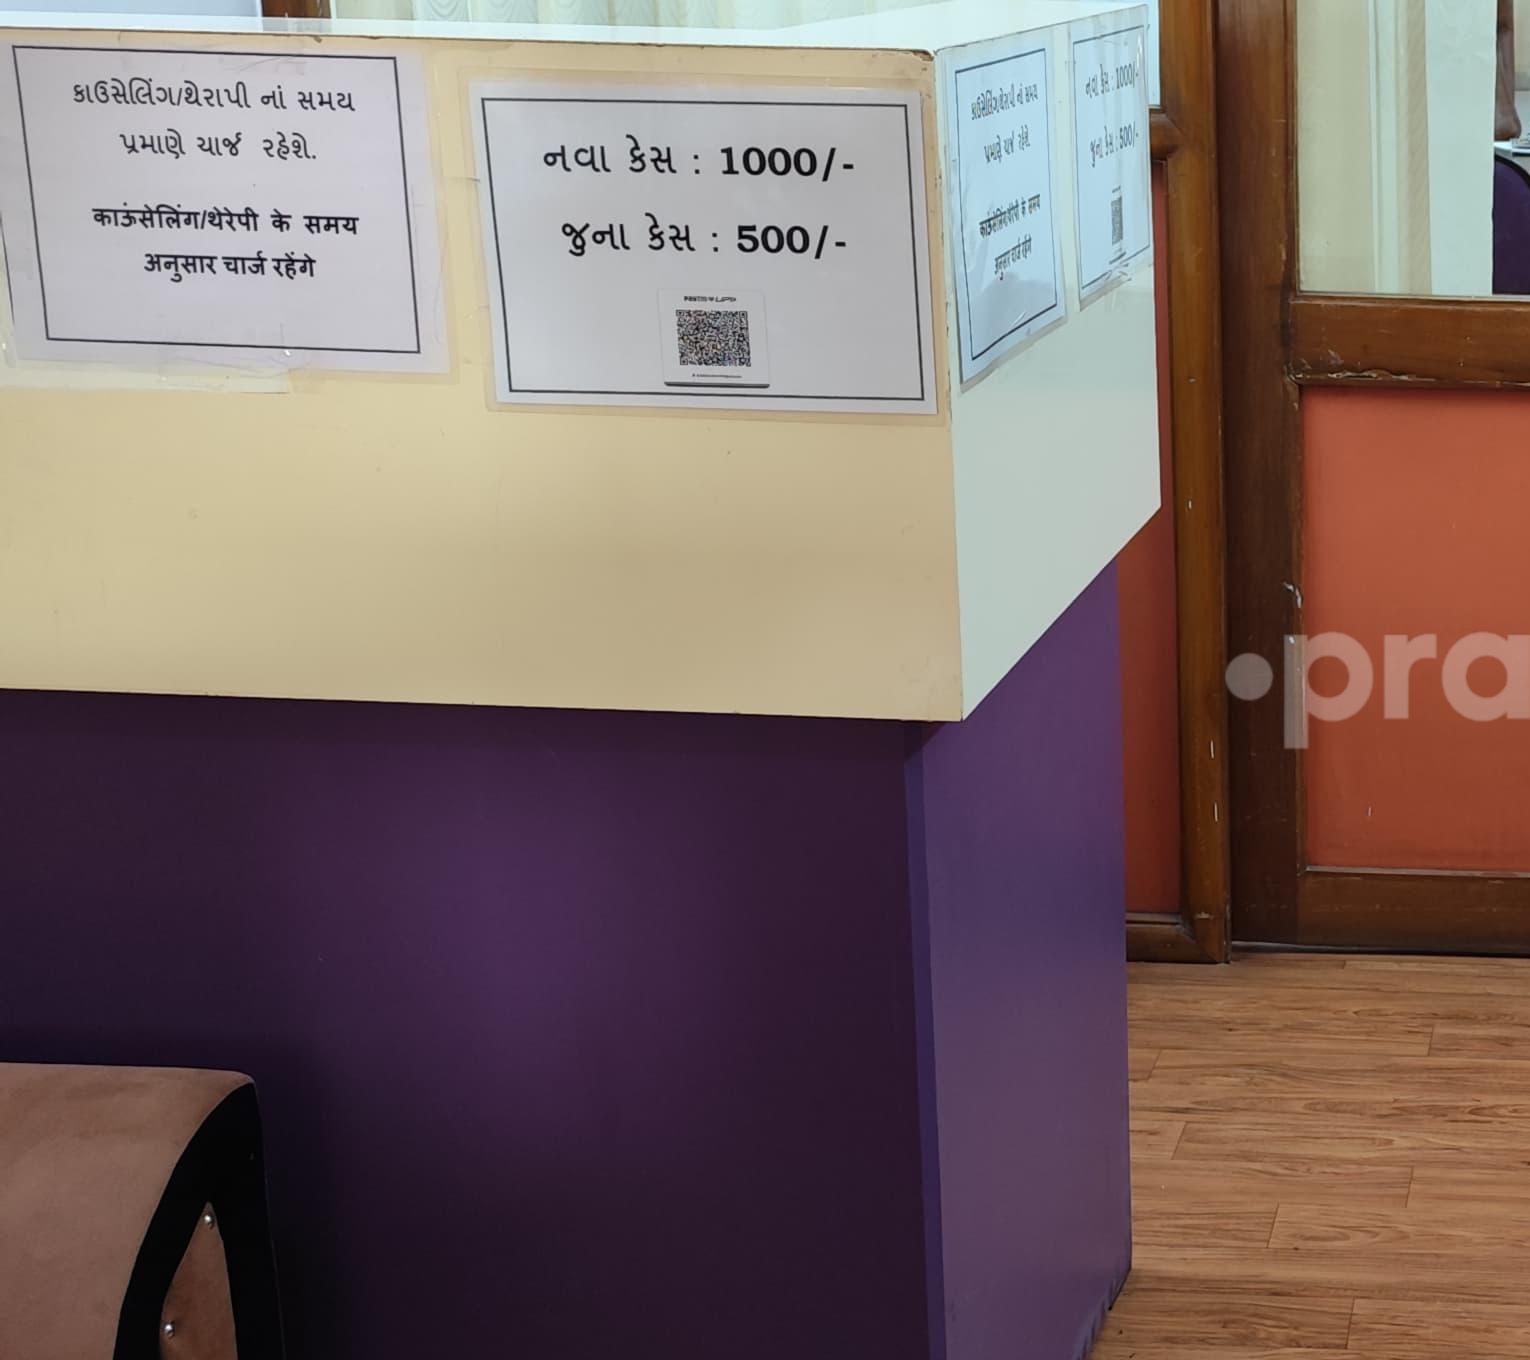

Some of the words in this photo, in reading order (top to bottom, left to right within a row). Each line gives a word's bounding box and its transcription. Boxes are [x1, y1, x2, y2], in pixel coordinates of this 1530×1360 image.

[74, 77, 251, 108] કાઉસેલિંગ/થેરાપી
[261, 85, 287, 109] નાં
[298, 91, 355, 111] સમય
[120, 128, 186, 159] પ્રમાણે
[197, 132, 242, 156] ચાર્જ
[263, 131, 316, 160] રહેશે.
[543, 145, 611, 172] નવા
[626, 134, 677, 174] કેસ
[721, 147, 854, 182] 1000/-
[270, 208, 292, 232] के
[303, 216, 359, 235] समय
[562, 223, 630, 257] જુના
[645, 212, 696, 251] કેસ
[737, 225, 846, 259] 500/-
[144, 253, 218, 283] अनुसार
[221, 250, 268, 275] चार्ज
[272, 251, 316, 280] रहेंगे
